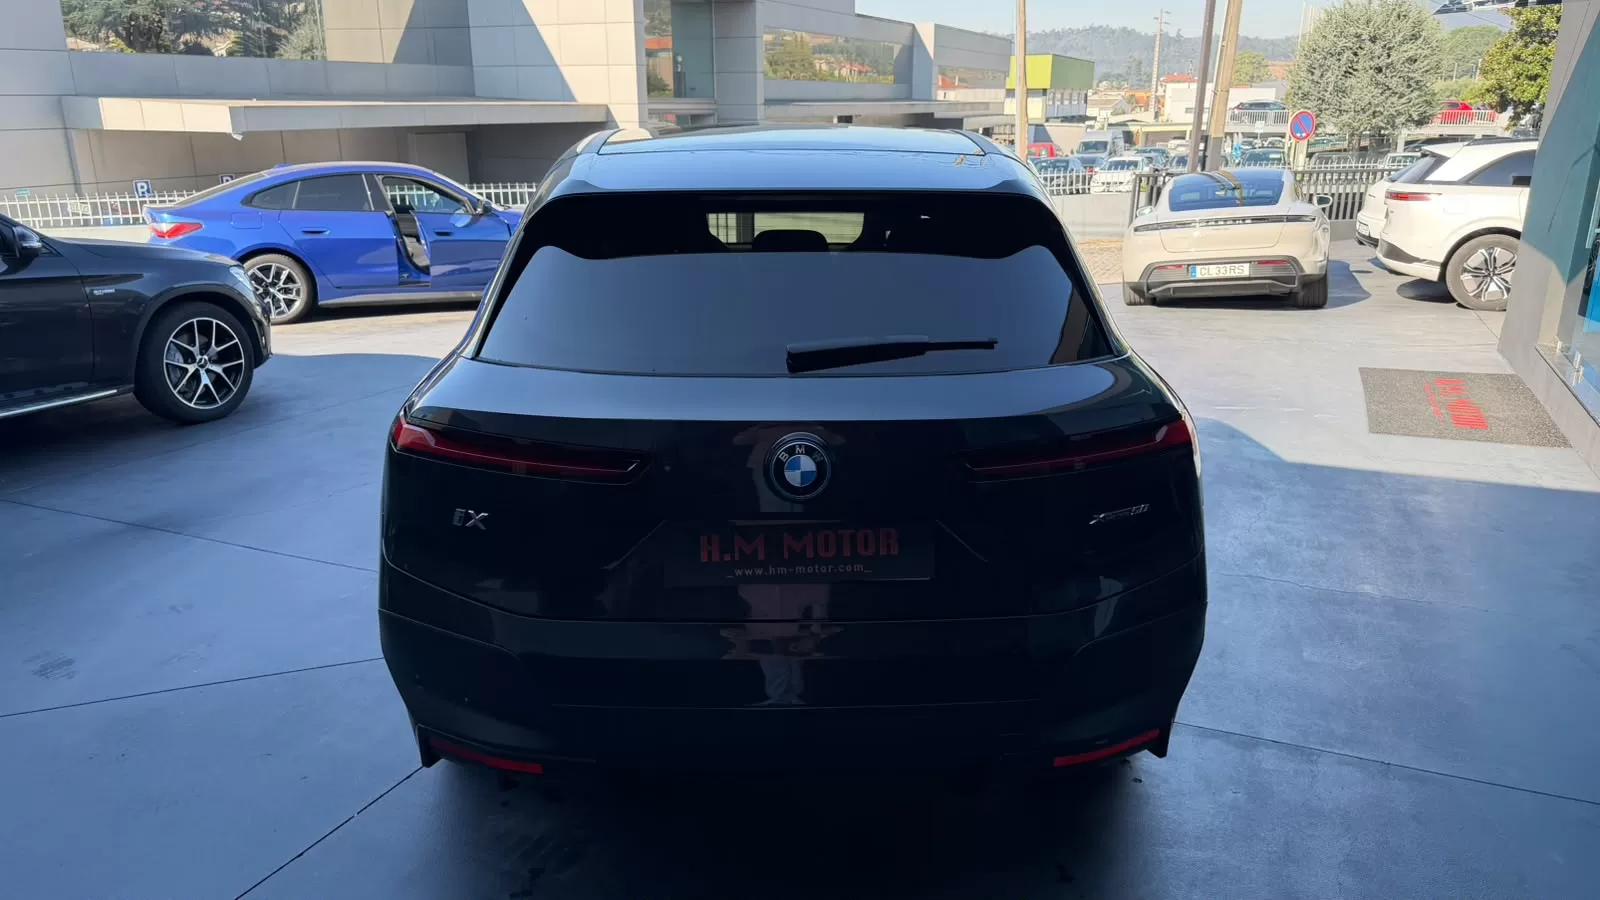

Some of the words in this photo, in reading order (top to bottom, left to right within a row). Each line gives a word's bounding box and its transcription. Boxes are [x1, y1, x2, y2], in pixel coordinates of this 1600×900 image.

[778, 444, 824, 463] BMW
[699, 532, 766, 563] H.M
[783, 527, 901, 560] MOTOR
